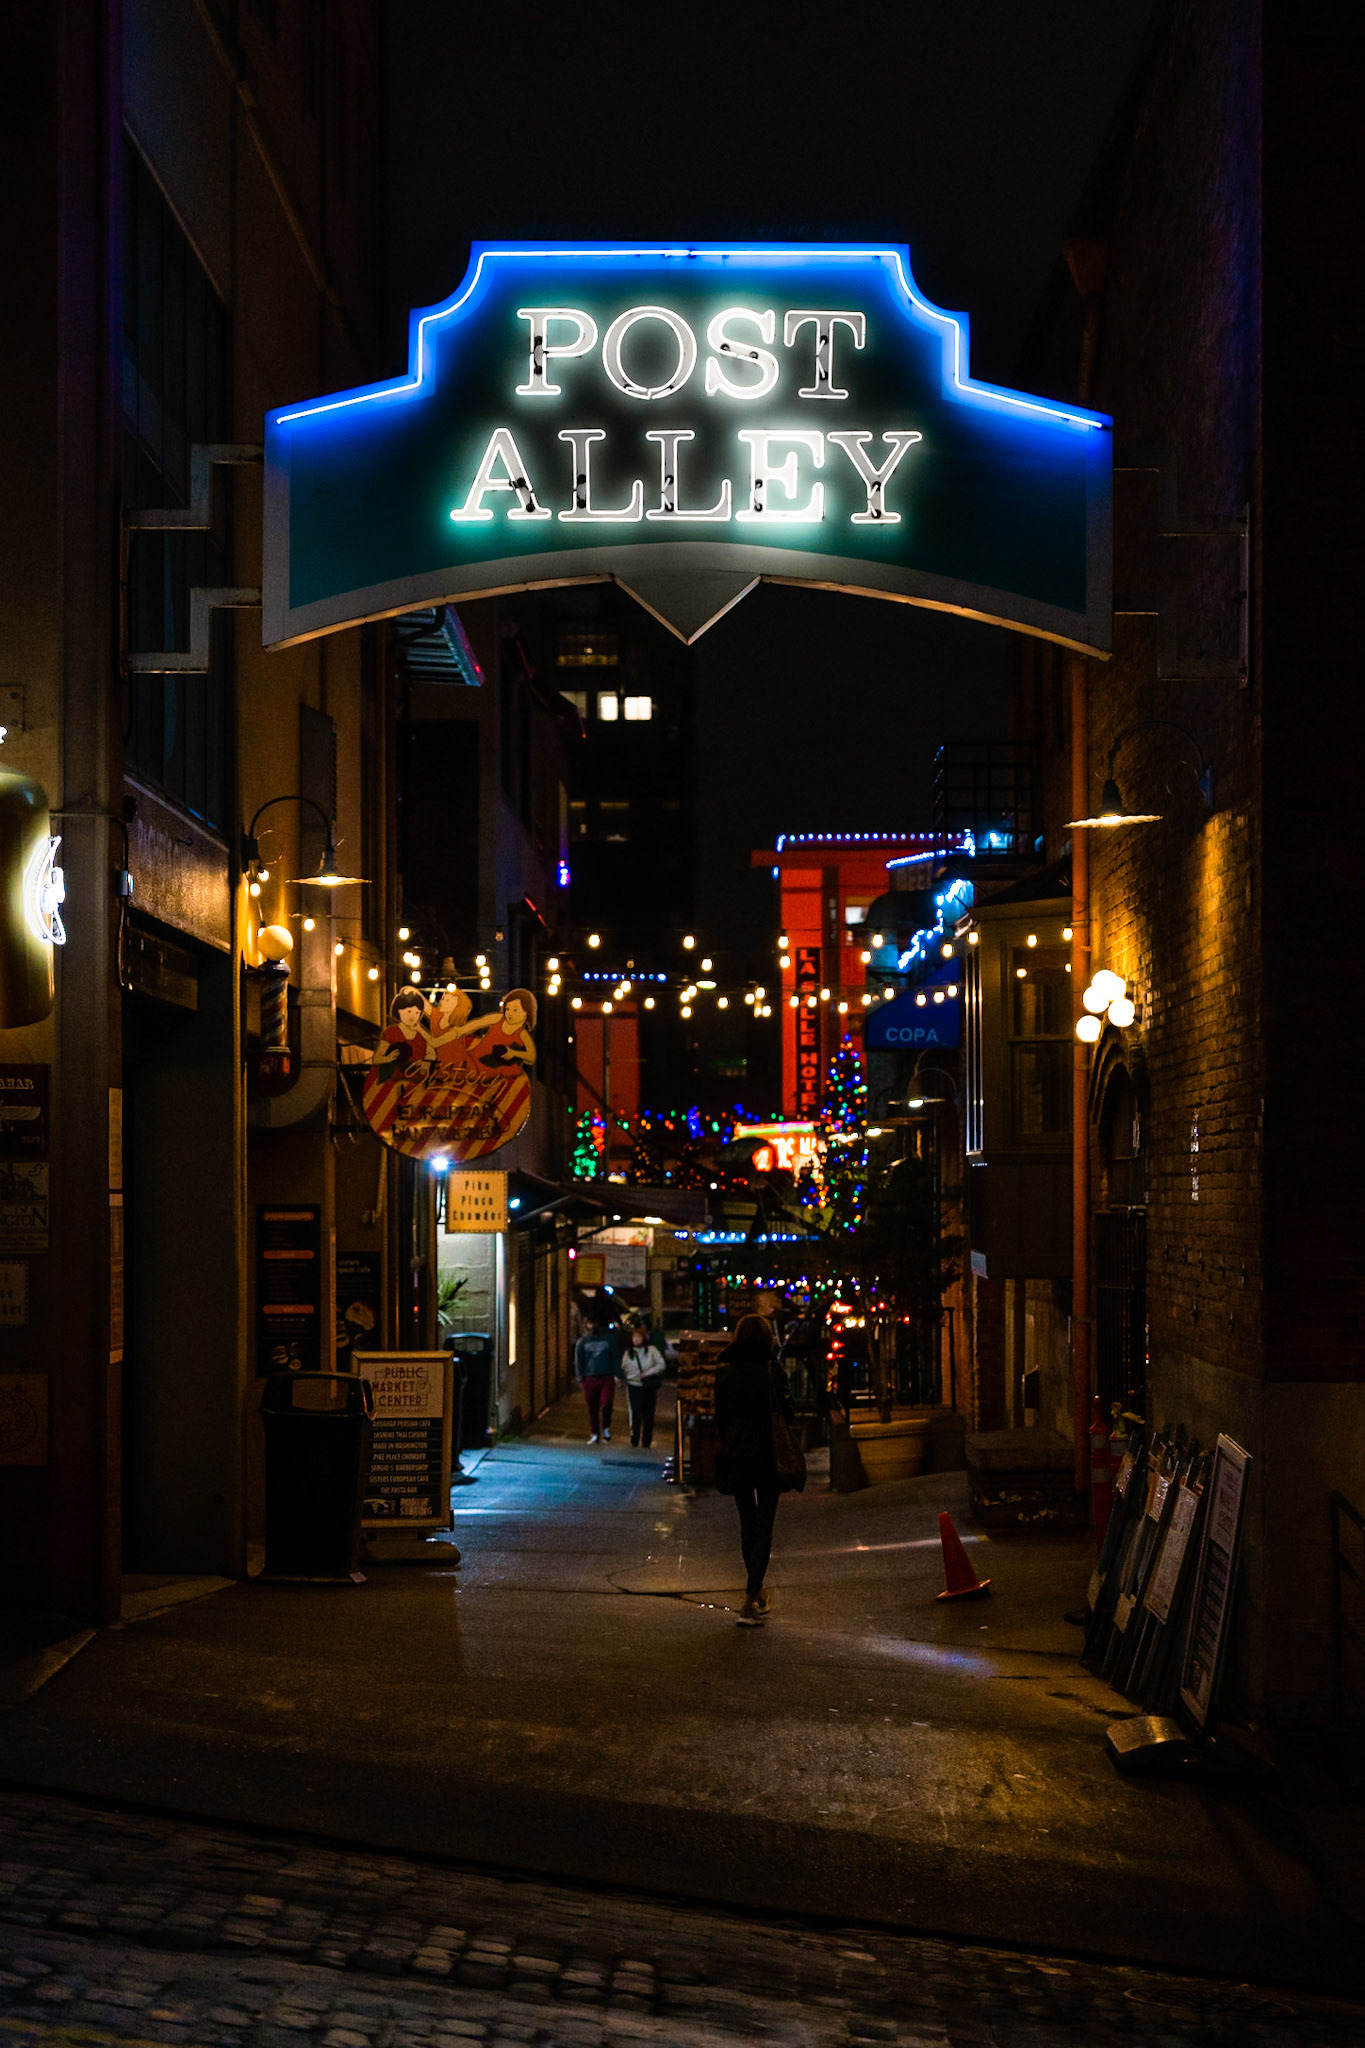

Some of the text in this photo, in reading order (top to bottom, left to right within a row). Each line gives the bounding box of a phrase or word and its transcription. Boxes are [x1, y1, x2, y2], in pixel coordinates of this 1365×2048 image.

[515, 305, 867, 400] POST
[449, 427, 923, 525] ALLEY
[885, 1027, 939, 1043] COPA
[465, 1180, 490, 1191] Pike
[461, 1194, 493, 1206] Place
[385, 1367, 424, 1379] PUBLIC
[372, 1380, 415, 1393] MARKET
[378, 1395, 422, 1407] CENTER
[369, 1475, 389, 1484] SISTERS
[417, 1475, 429, 1483] CAFE
